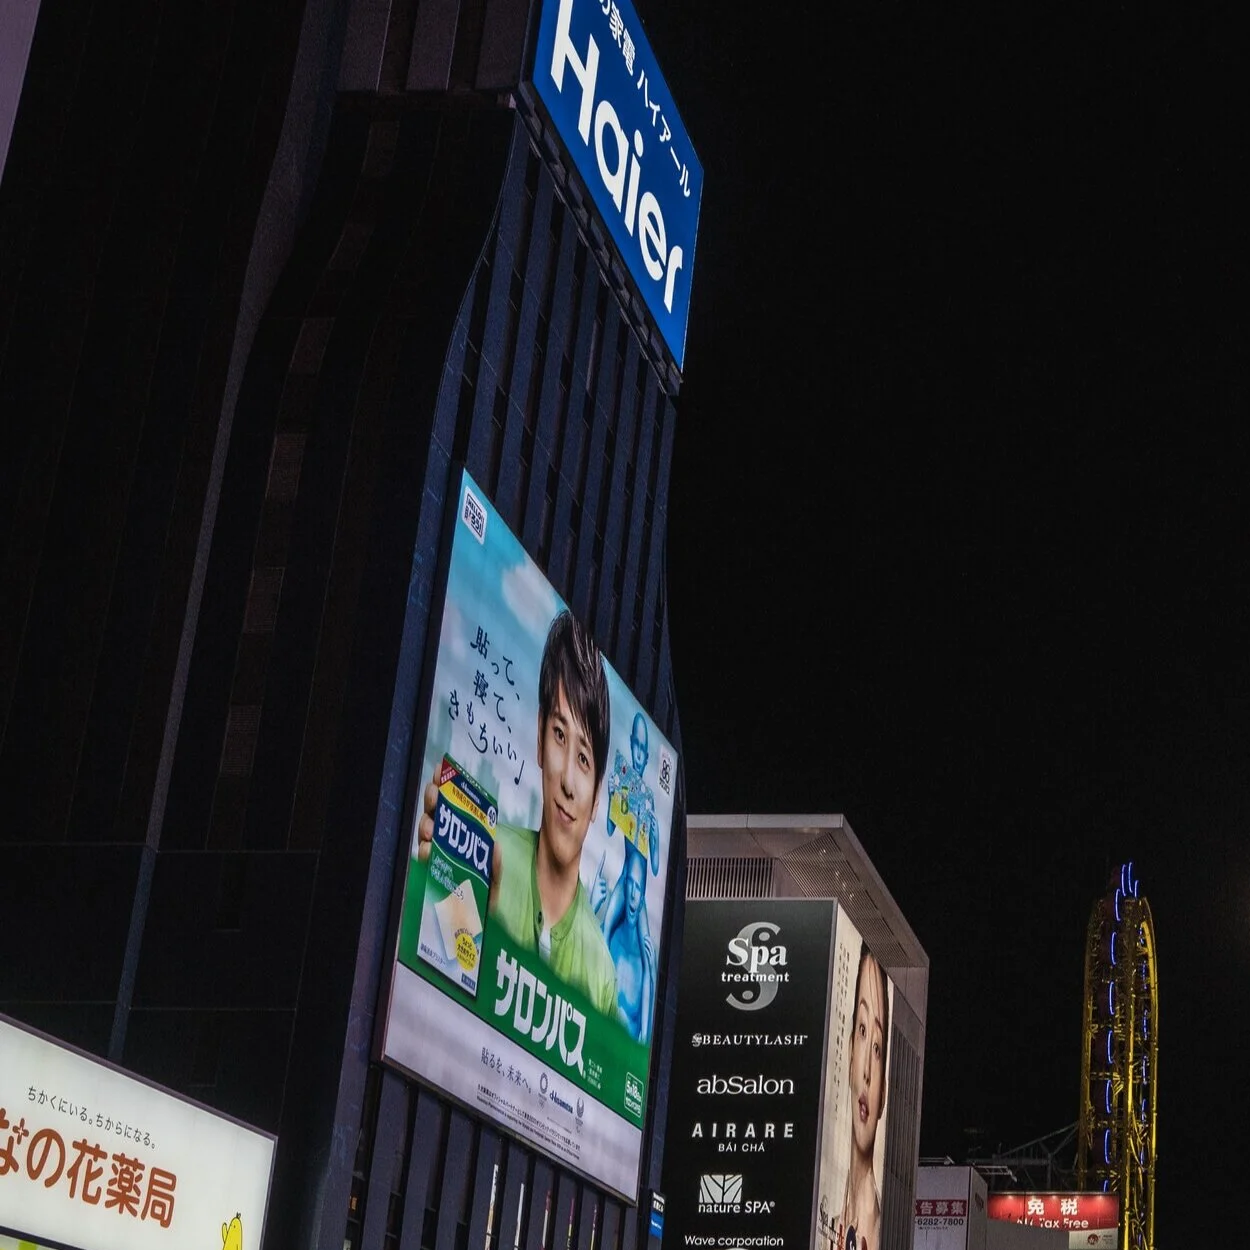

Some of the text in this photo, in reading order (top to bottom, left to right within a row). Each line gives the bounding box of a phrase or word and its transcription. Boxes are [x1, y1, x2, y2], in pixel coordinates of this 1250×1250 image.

[636, 69, 690, 197] ハイアール
[551, 0, 682, 313] Haier
[470, 625, 520, 701] 貼って、
[473, 669, 512, 734] 寝て、
[437, 803, 489, 876] サロンパス
[726, 937, 787, 975] Spa
[720, 971, 790, 983] treatment
[494, 948, 586, 1078] サロンパス
[696, 1075, 794, 1096] abSalon
[27, 1085, 157, 1150] ちかくにいる。ちからになる。
[691, 1122, 795, 1139] AIRARE
[697, 1202, 741, 1214] nature
[915, 1201, 965, 1215] 告募集
[1062, 1216, 1089, 1229] Free
[683, 1235, 785, 1248] Wave corporation
